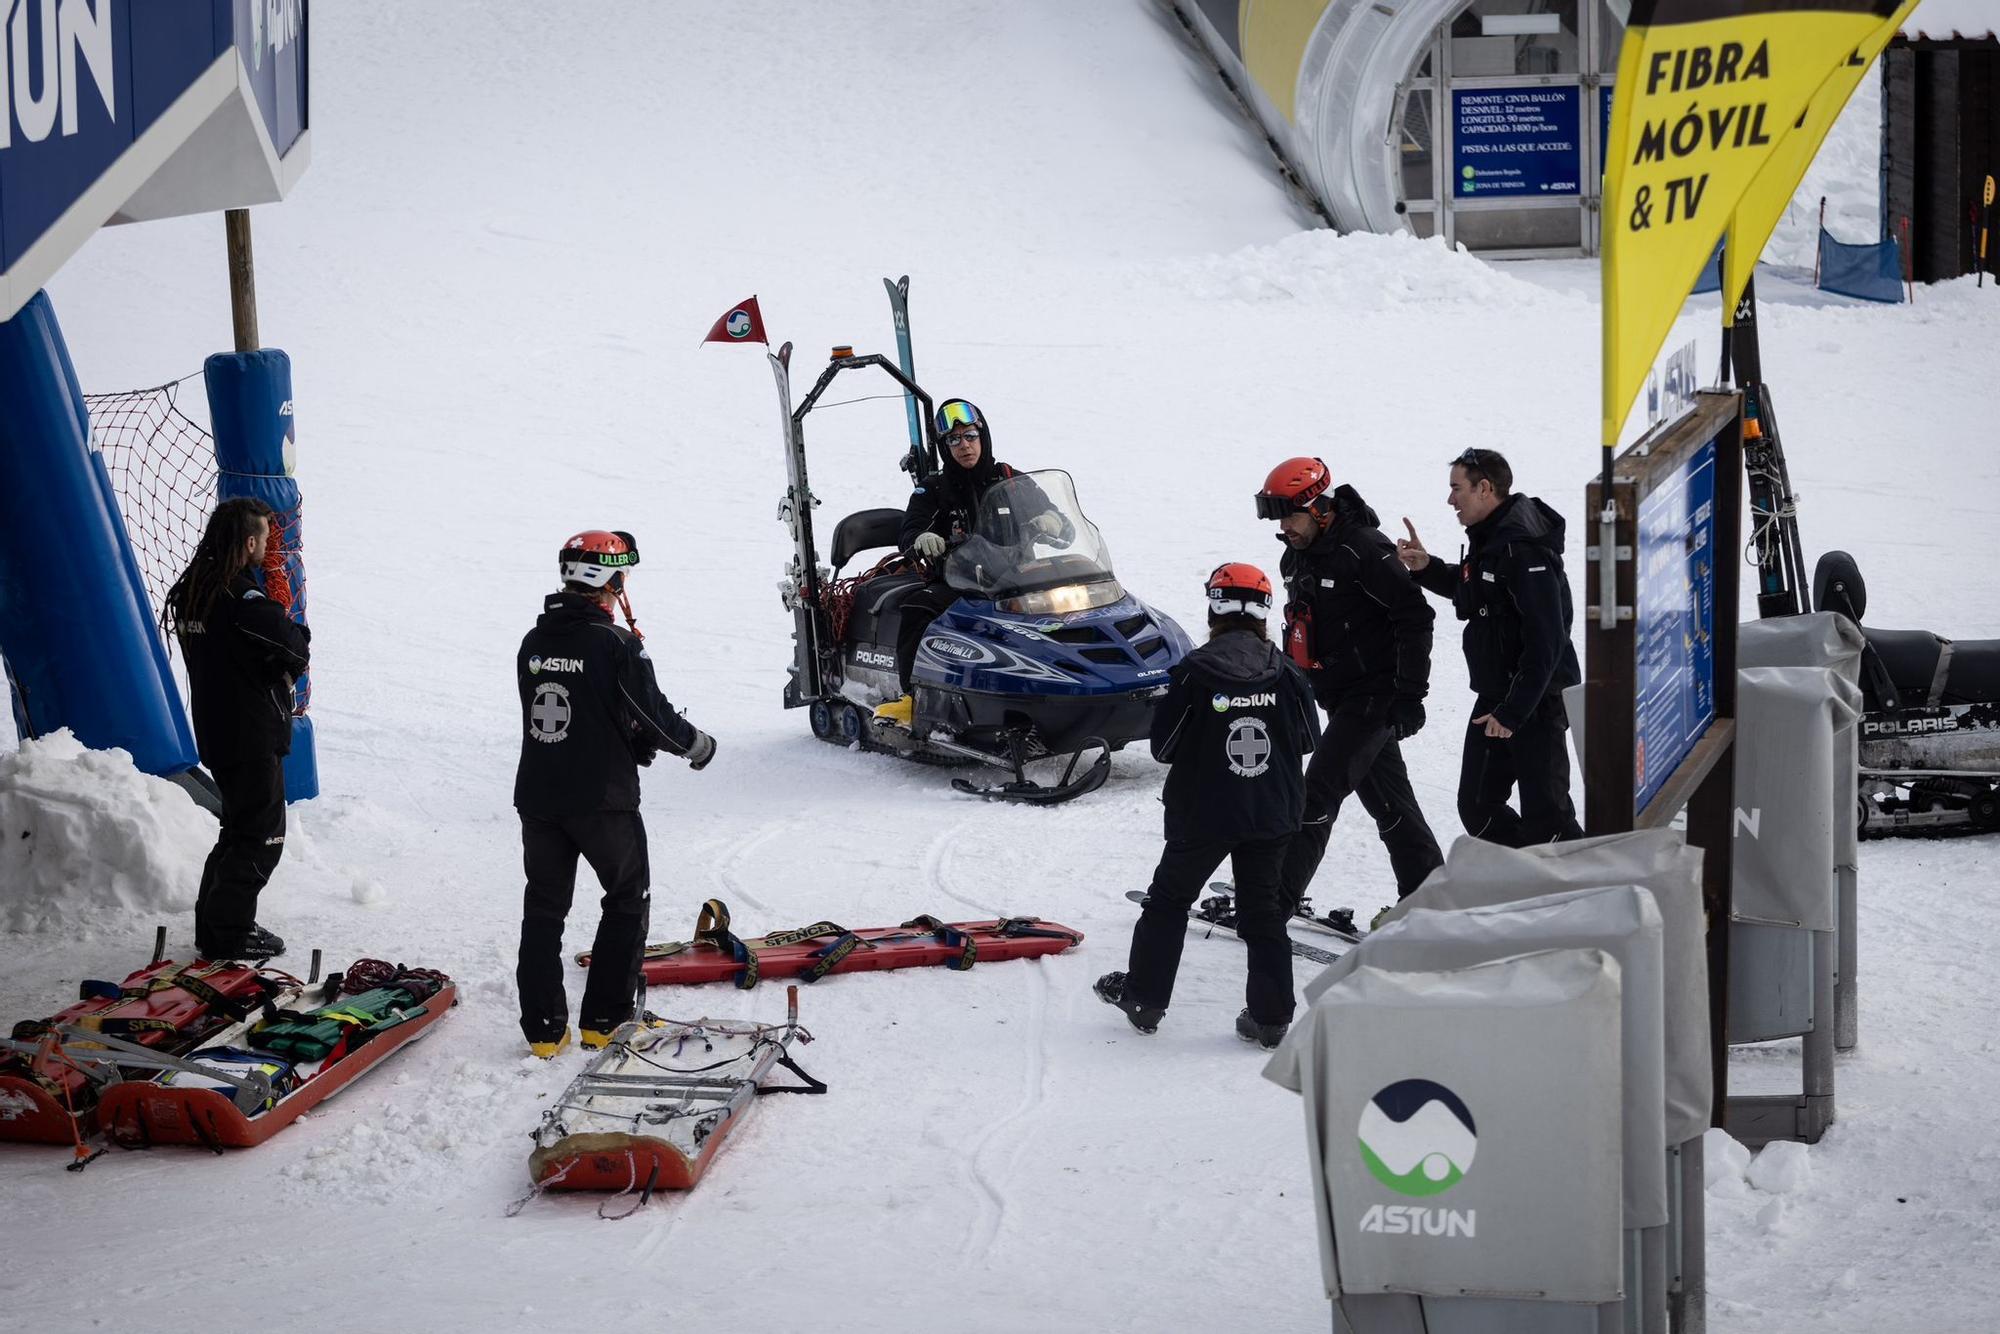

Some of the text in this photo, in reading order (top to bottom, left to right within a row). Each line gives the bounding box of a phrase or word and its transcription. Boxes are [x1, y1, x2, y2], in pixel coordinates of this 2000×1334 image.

[1646, 39, 1769, 95] FIBRA
[1505, 94, 1530, 103] CINTA
[1461, 105, 1504, 115] DESNIVEL:
[1505, 105, 1514, 113] 12
[1461, 115, 1506, 124] LONGITUD:
[1507, 114, 1518, 122] 90
[1633, 102, 1770, 166] MÓVIL
[1462, 145, 1490, 153] PISTAS
[1491, 144, 1498, 152] A
[1500, 144, 1516, 152] LAS
[1517, 143, 1535, 152] QUE
[1630, 174, 1709, 231] & TV
[599, 552, 629, 565] ULLER
[541, 657, 584, 673] ASTUN
[856, 650, 895, 668] POLARIS
[1231, 693, 1276, 708] ASTUN
[1864, 717, 1958, 735] POLARIS
[1360, 1204, 1476, 1237] ASTUN
